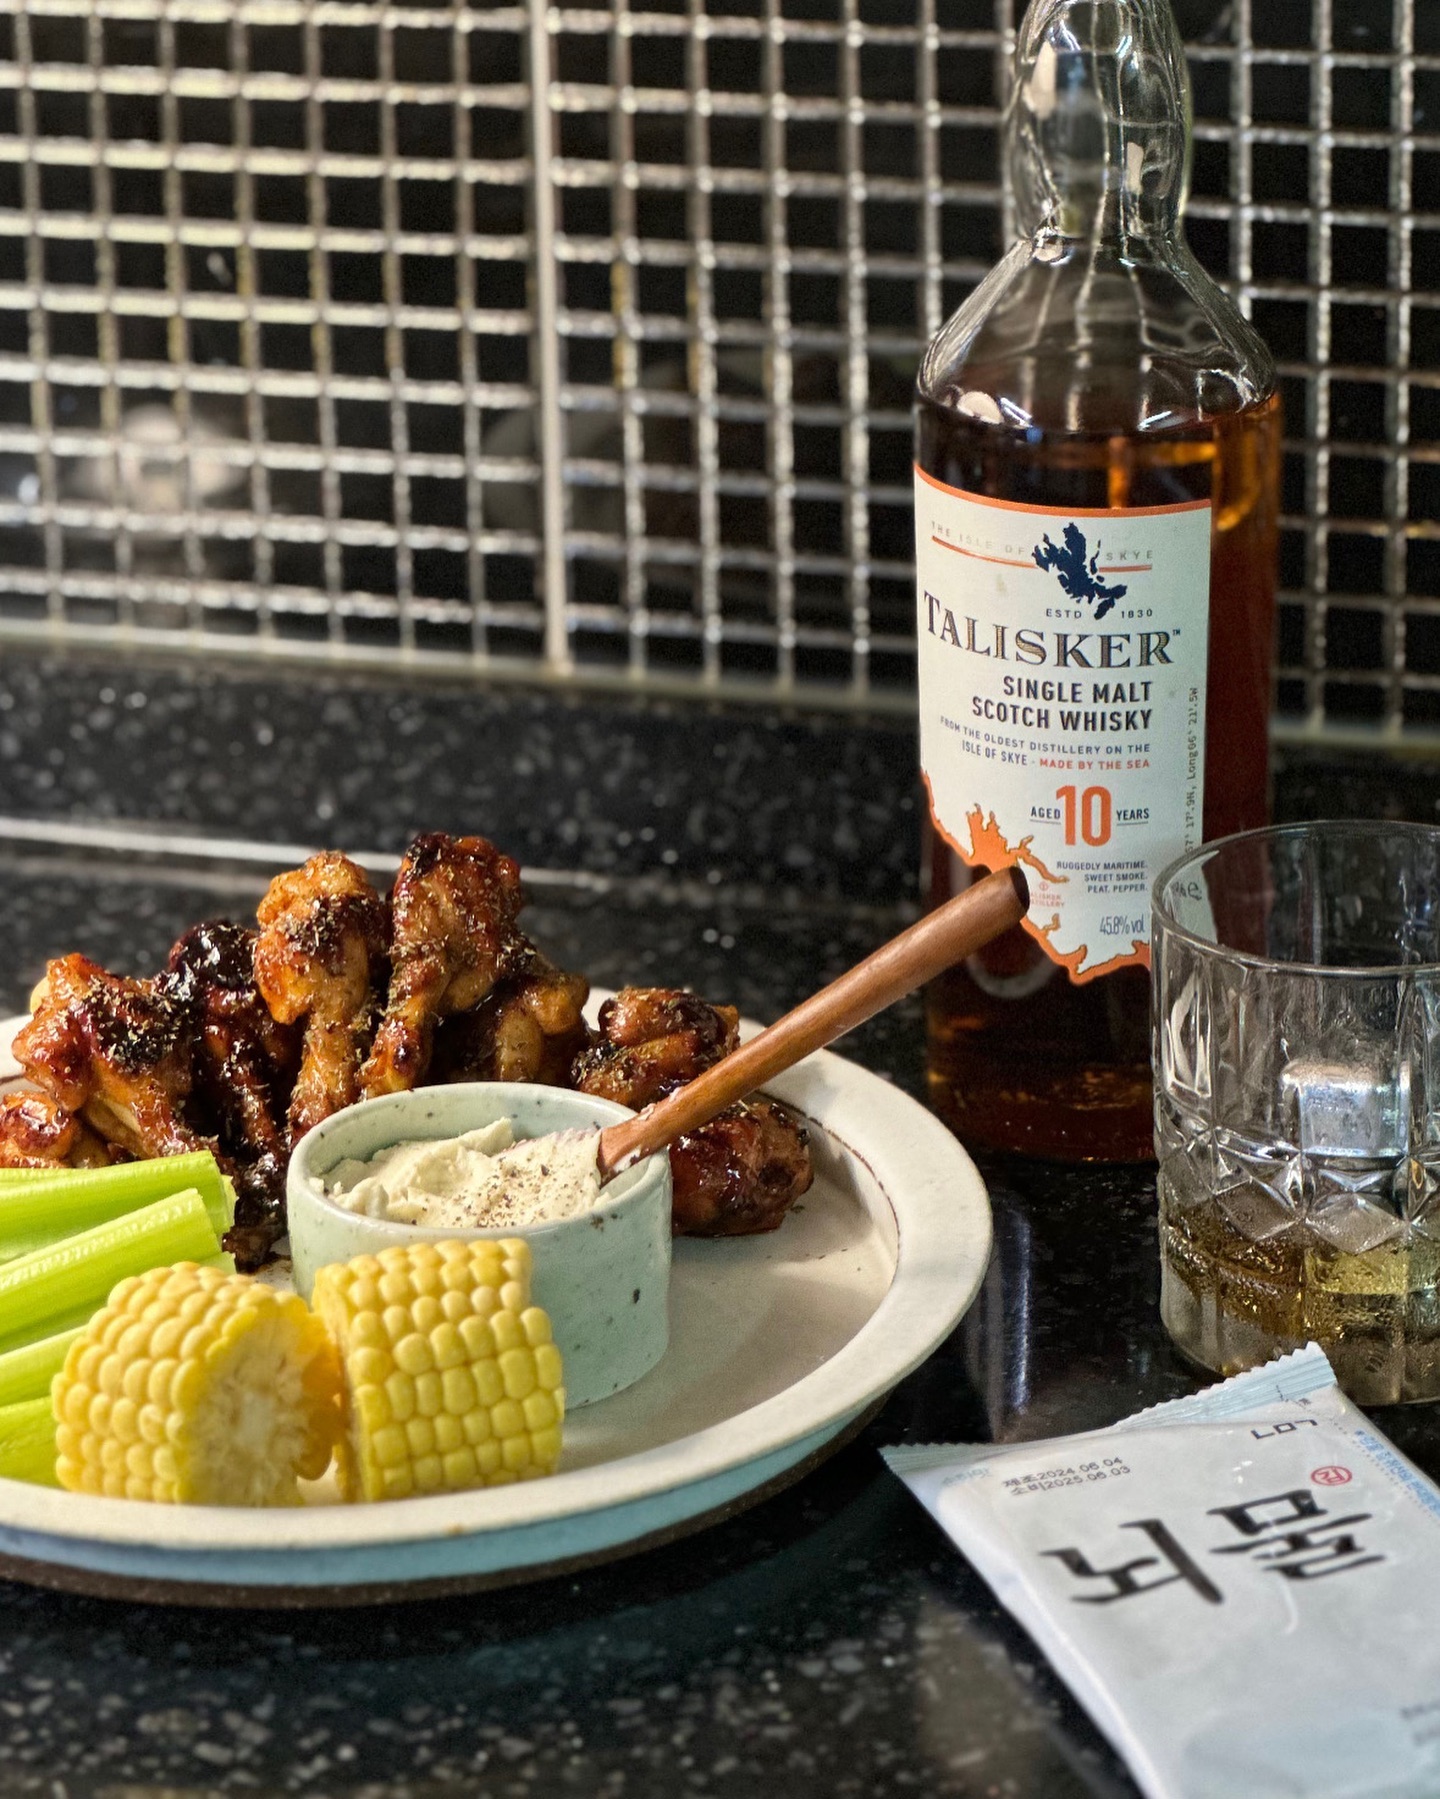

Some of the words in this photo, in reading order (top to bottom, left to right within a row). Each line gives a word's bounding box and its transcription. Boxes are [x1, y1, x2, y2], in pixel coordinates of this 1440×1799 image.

[932, 521, 951, 538] THE
[959, 533, 993, 550] ISLE
[1005, 545, 1025, 555] OF
[1106, 550, 1154, 561] SKYE
[1046, 608, 1082, 619] ESTD
[1121, 608, 1153, 619] 1830
[1003, 675, 1083, 703] SINGLE
[1092, 681, 1152, 704] MALT
[972, 696, 1050, 730] SCOTCH
[1060, 708, 1152, 732] WHISKY
[940, 716, 961, 733] FROM
[963, 726, 981, 740] THE
[984, 733, 1025, 749] OLDEST
[1029, 741, 1101, 755] DISTILLERY
[1105, 745, 1122, 754] ON
[1128, 743, 1150, 753] THE
[962, 740, 982, 756] ISLE
[985, 747, 997, 760] OF
[1001, 751, 1028, 766] SKYE
[1039, 758, 1073, 769] MADE
[1078, 761, 1093, 770] BY
[1098, 760, 1122, 770] THE
[1127, 758, 1150, 769] SEA
[1031, 806, 1061, 819] AGED
[1056, 785, 1112, 847] 10
[1116, 808, 1150, 821] YEARS
[1057, 861, 1101, 871] RUGGEDLY
[1084, 873, 1113, 882] SWEET
[1131, 914, 1145, 934] vol
